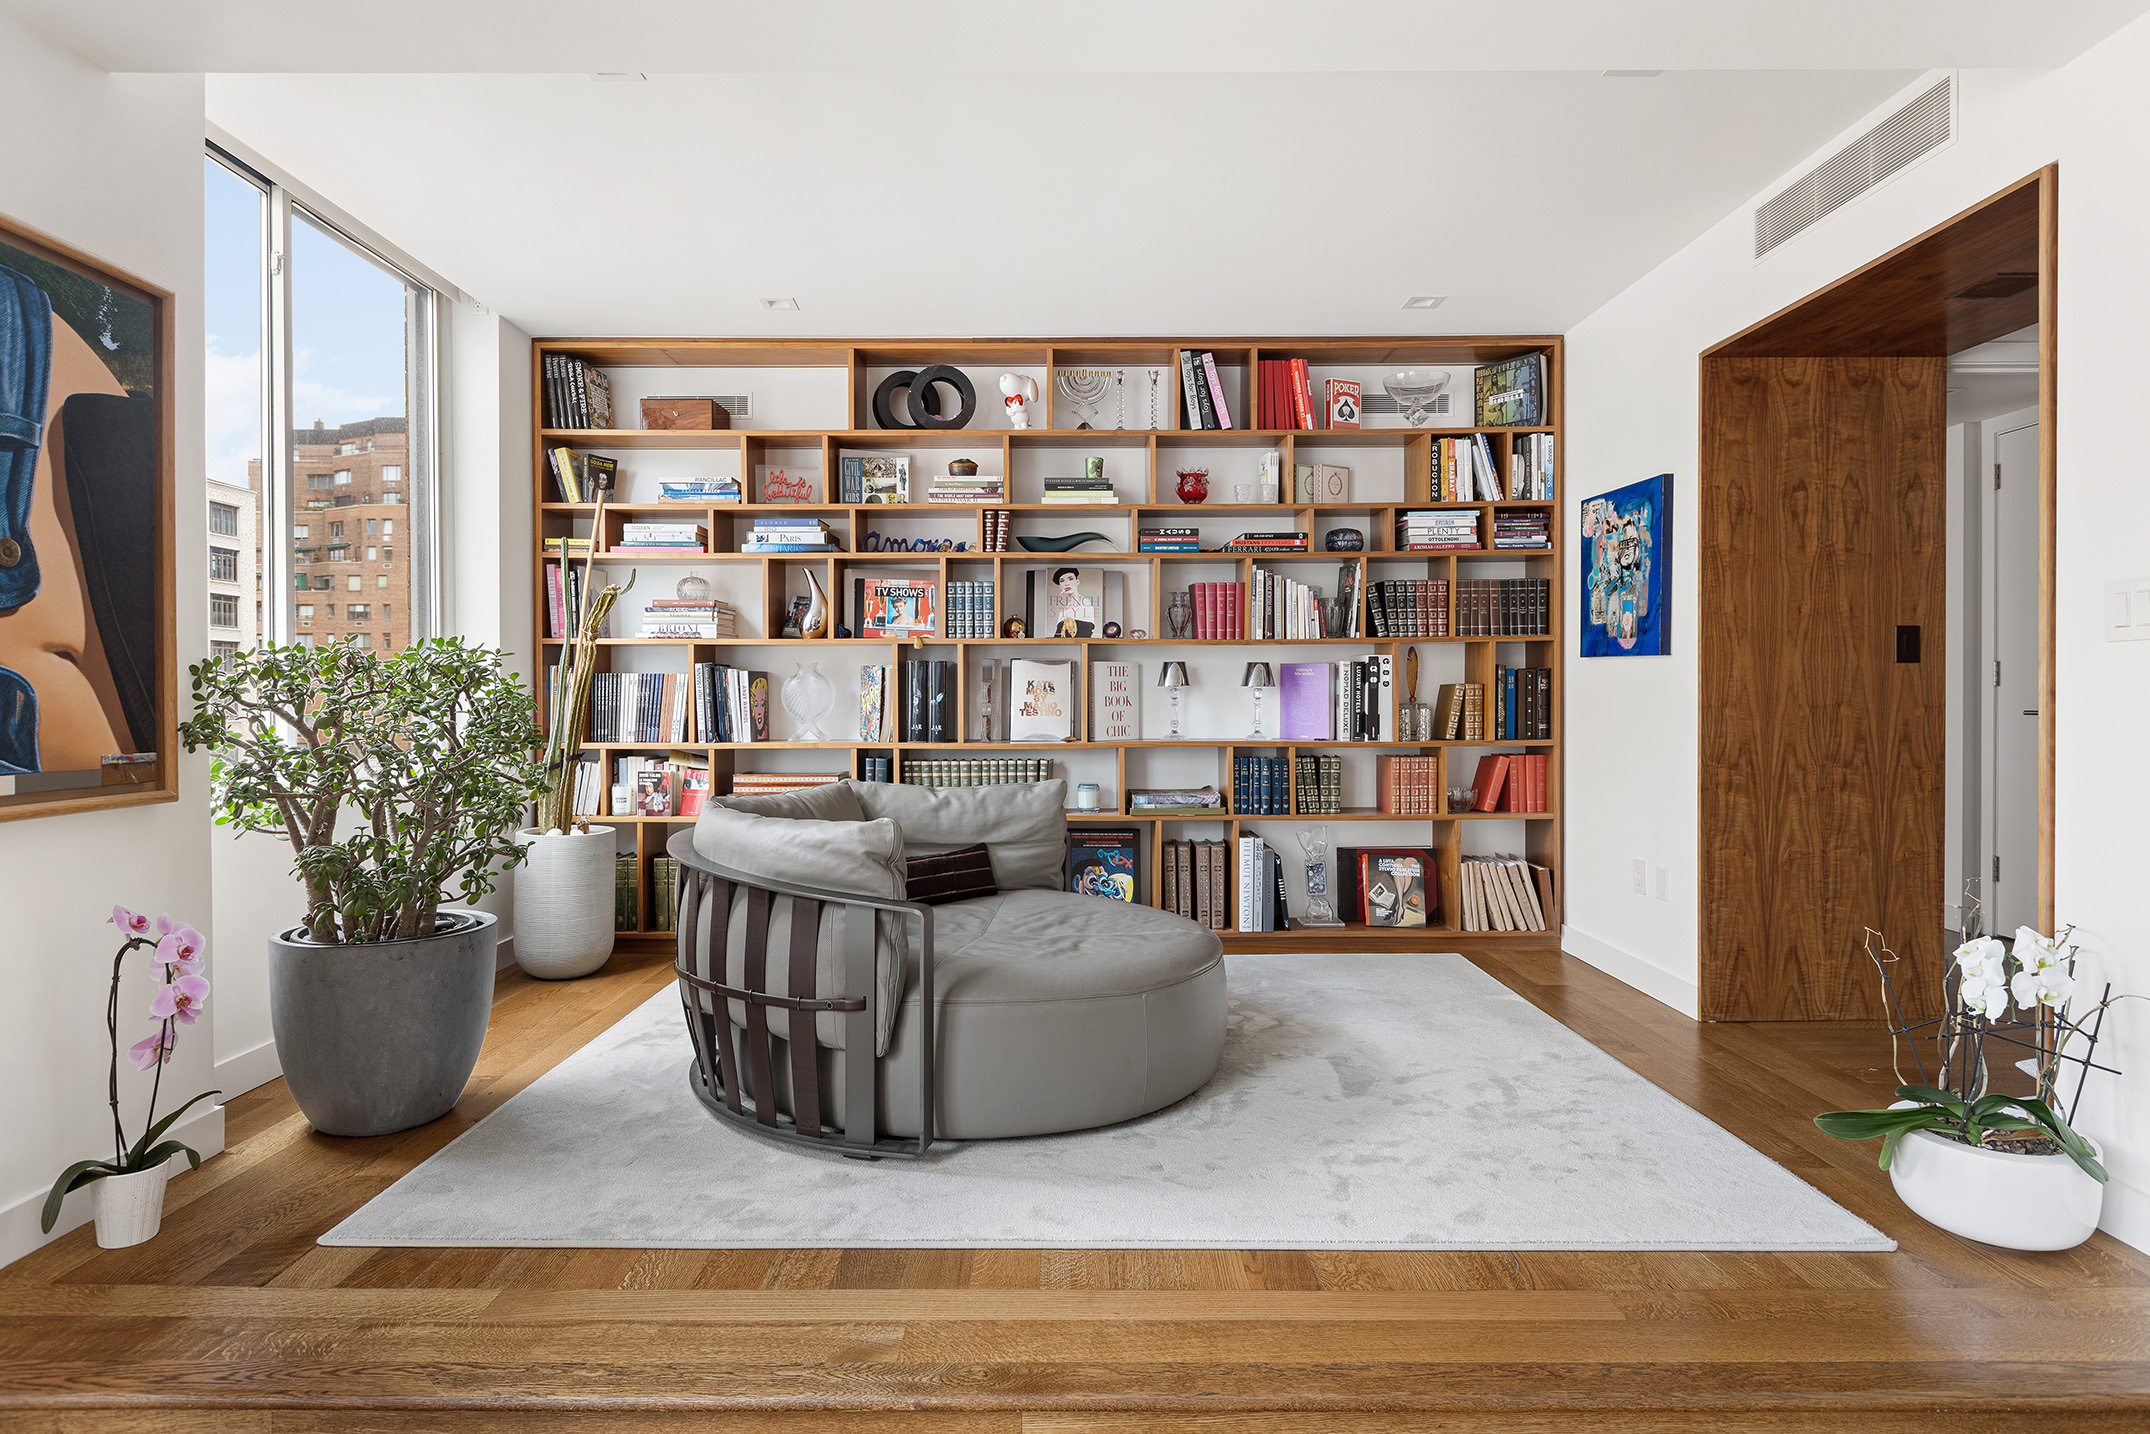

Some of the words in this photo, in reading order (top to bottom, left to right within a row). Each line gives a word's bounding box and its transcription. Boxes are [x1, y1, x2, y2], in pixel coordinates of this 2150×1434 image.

[574, 362, 584, 388] SMOKE
[579, 394, 588, 414] FIRE
[1334, 381, 1360, 398] POKER
[1217, 398, 1226, 414] Girls
[844, 460, 860, 476] CIVIL
[770, 469, 788, 485] life
[844, 476, 860, 490] WAR
[761, 484, 815, 504] beautiful
[844, 492, 860, 502] KIDS
[780, 534, 802, 542] PARIS
[876, 587, 889, 596] TV
[890, 588, 924, 597] SHOWS
[1049, 596, 1100, 607] FRENCH
[1049, 608, 1100, 618] STYLE
[1107, 666, 1128, 677] THE
[1028, 680, 1054, 689] KATE
[1110, 681, 1126, 692] BIG
[1026, 687, 1055, 695] MOSS
[1034, 694, 1047, 702] BY
[1104, 696, 1132, 707] BOOK
[1024, 702, 1057, 710] MARIO
[1019, 708, 1062, 716] TESTINO
[1112, 711, 1125, 721] OF
[1106, 725, 1130, 737] CHIC
[1243, 841, 1251, 880] HELMUT
[1243, 883, 1251, 924] NEWTON
